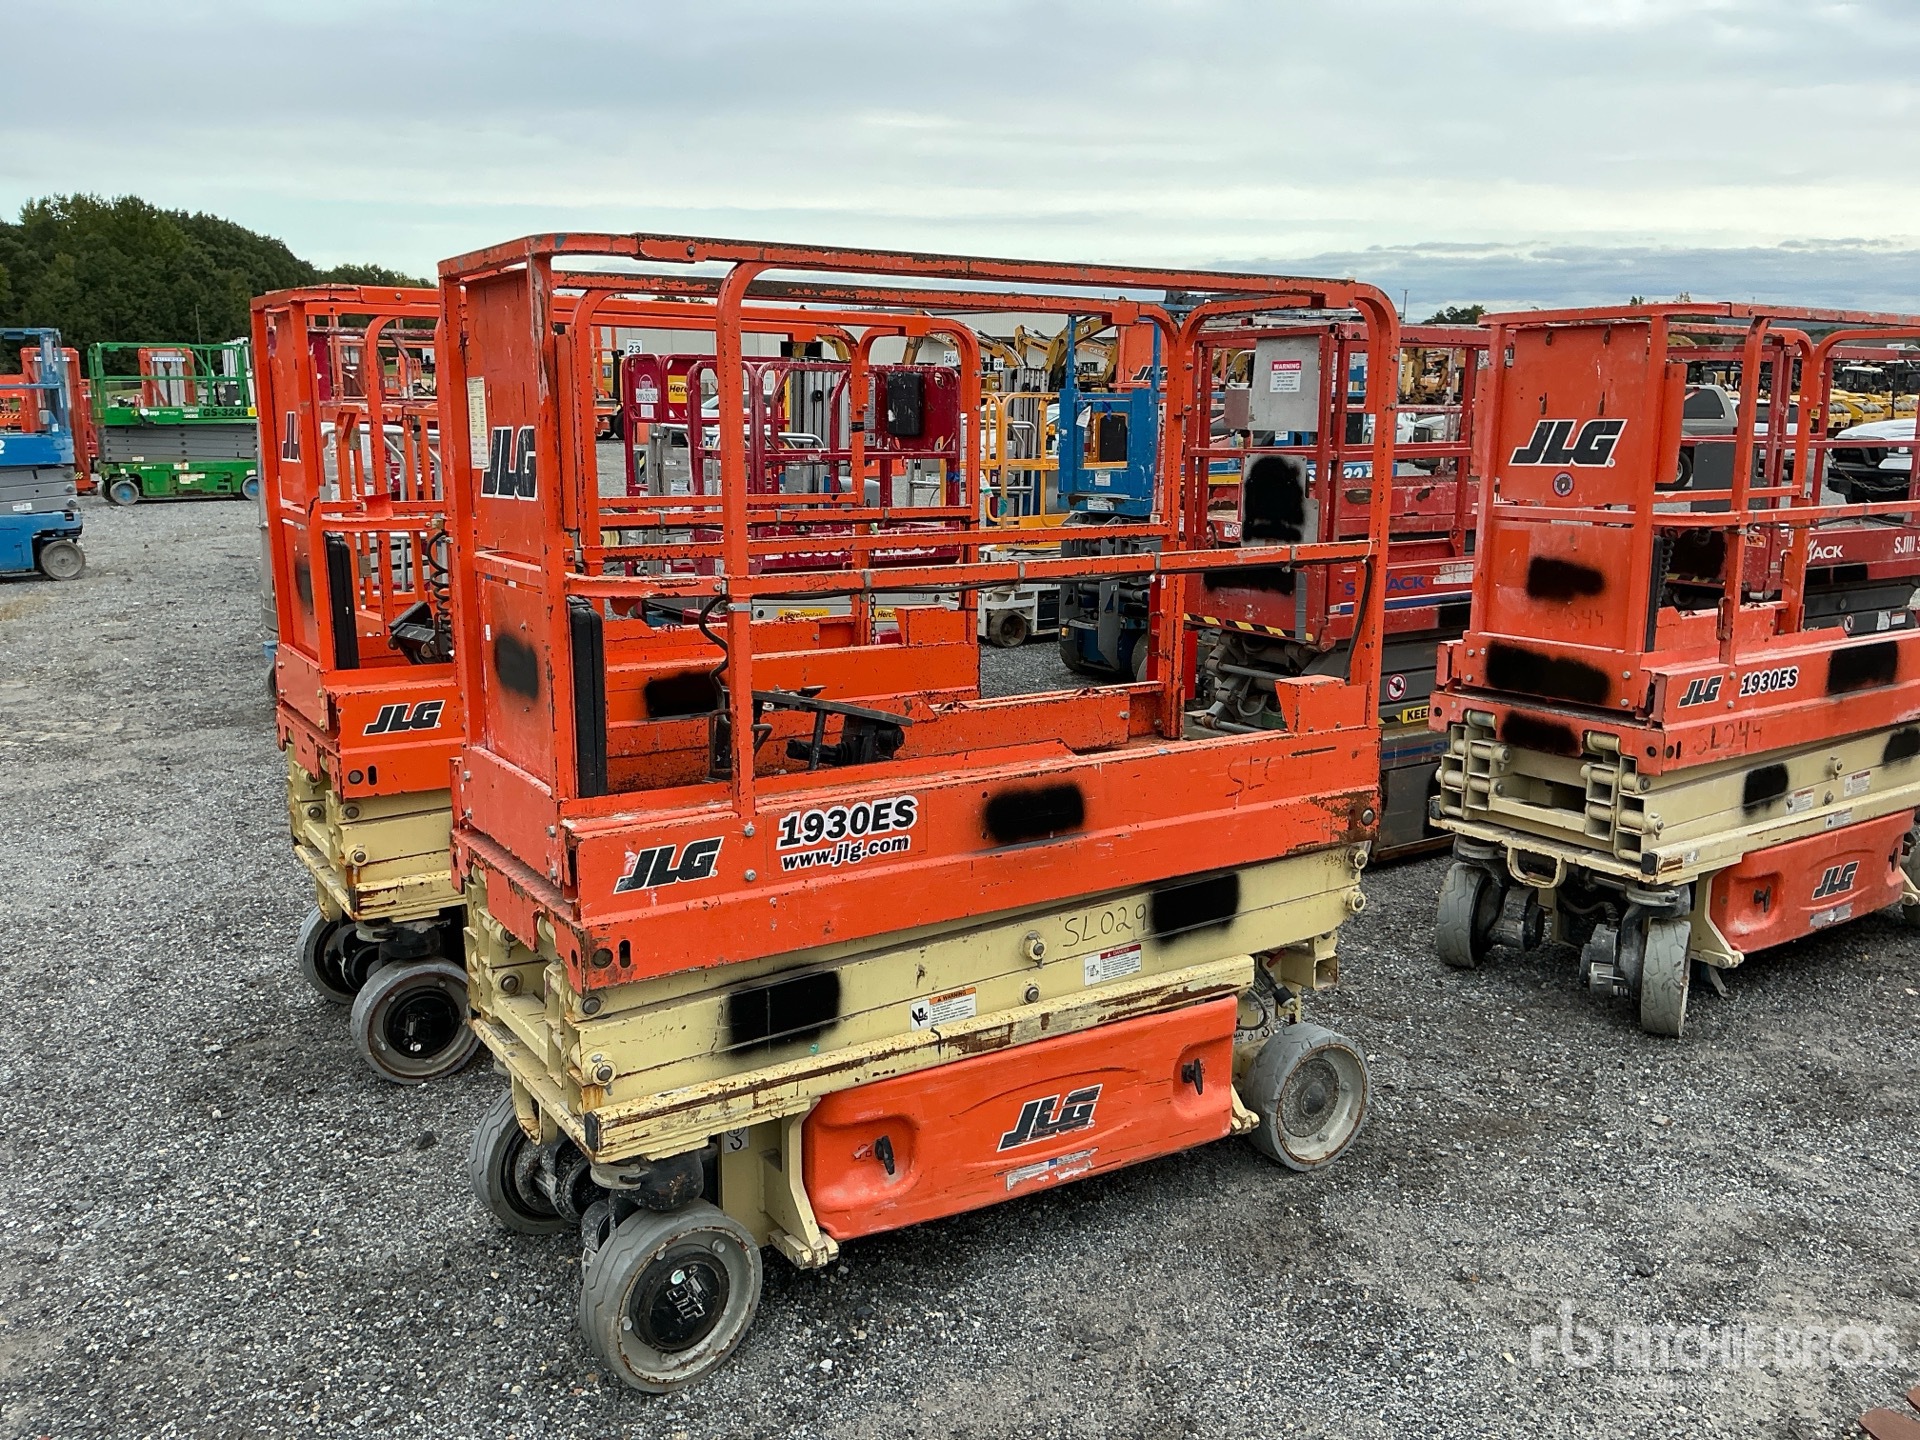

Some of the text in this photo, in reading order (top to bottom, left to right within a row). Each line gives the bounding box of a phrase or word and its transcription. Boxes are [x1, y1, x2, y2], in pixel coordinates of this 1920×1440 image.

[628, 344, 641, 354] 23
[203, 408, 249, 417] GS-3246
[481, 425, 538, 501] JLG
[1508, 419, 1628, 468] JLG
[1678, 666, 1799, 708] JLG 1930ES
[362, 699, 446, 736] JLG
[777, 796, 918, 849] 1930ES
[613, 836, 725, 894] JLG
[781, 836, 911, 871] www.jlg.com
[1812, 861, 1860, 900] JLG
[943, 989, 967, 1001] WARNING
[996, 1083, 1103, 1152] JLG
